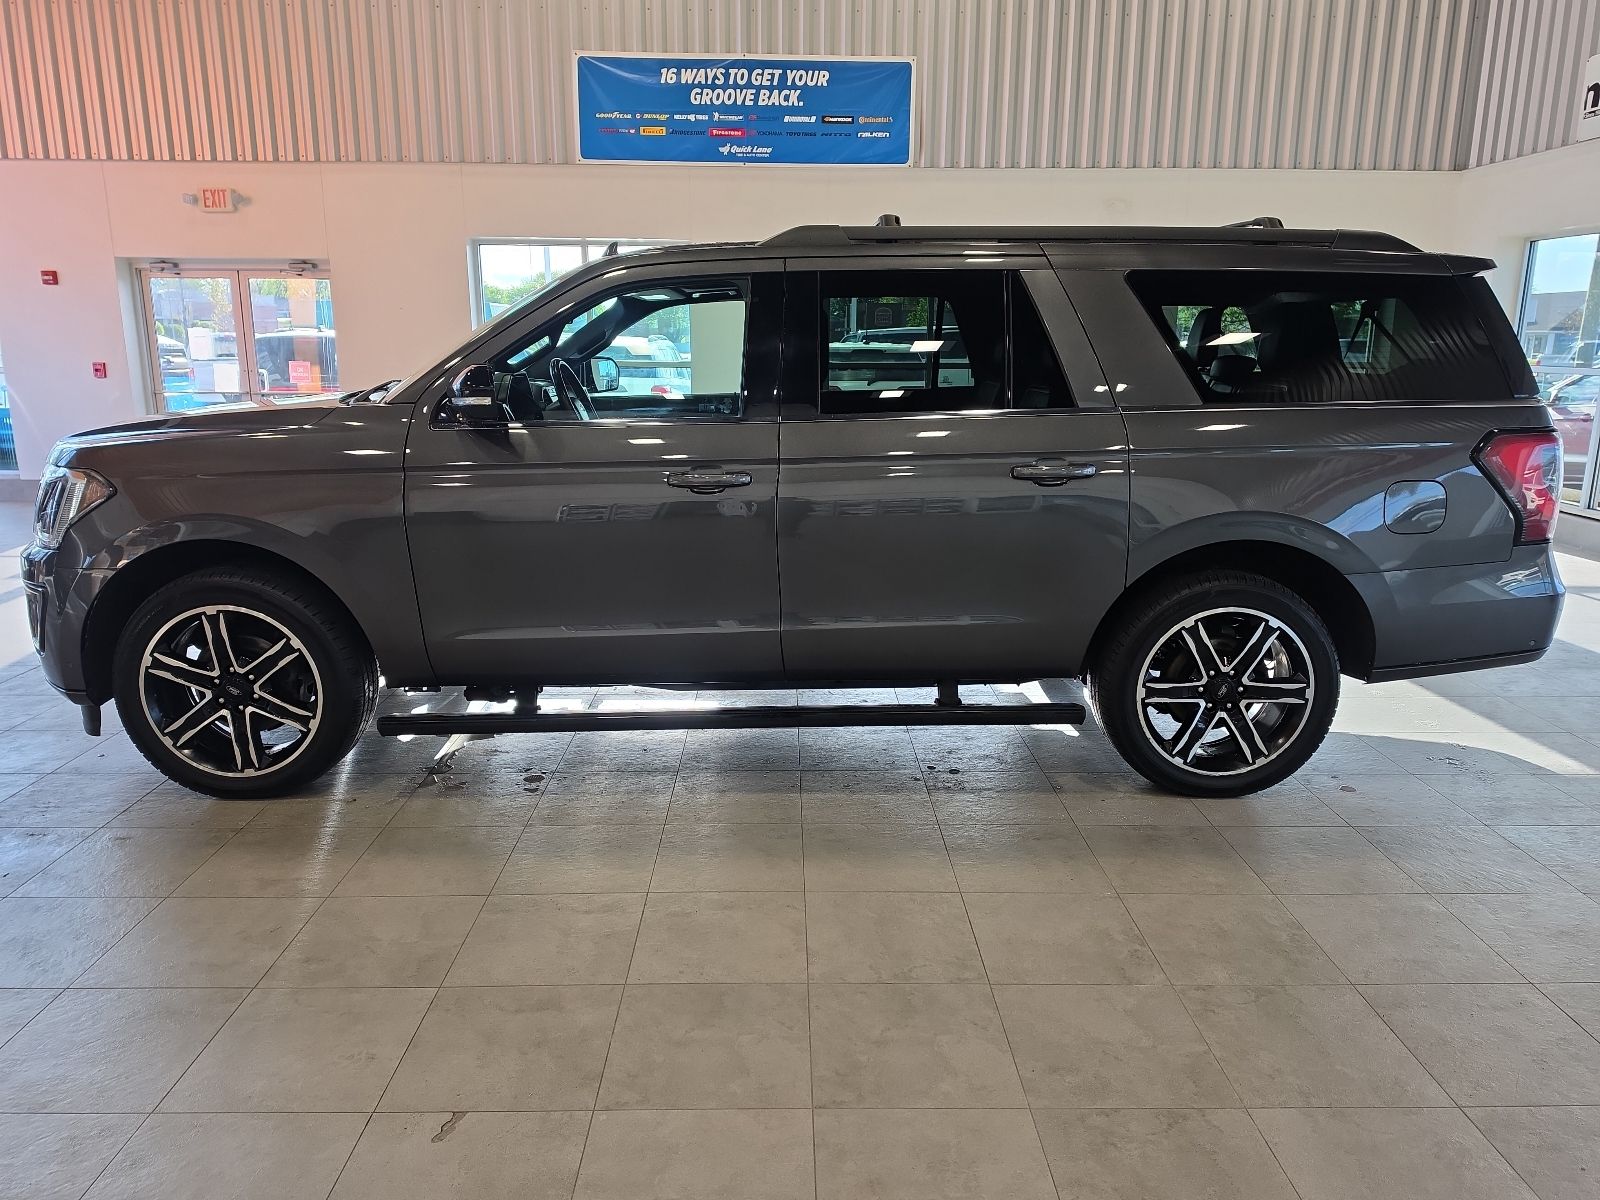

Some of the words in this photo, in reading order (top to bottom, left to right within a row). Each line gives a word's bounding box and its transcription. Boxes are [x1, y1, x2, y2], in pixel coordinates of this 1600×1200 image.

[660, 67, 677, 84] 16
[680, 68, 726, 85] WAYS
[728, 68, 749, 85] TO
[751, 68, 783, 86] GET
[786, 69, 830, 87] YOUR
[690, 88, 756, 105] GROOVE
[757, 89, 804, 107] BACK.
[730, 145, 752, 153] Quick
[202, 189, 227, 208] EXIT
